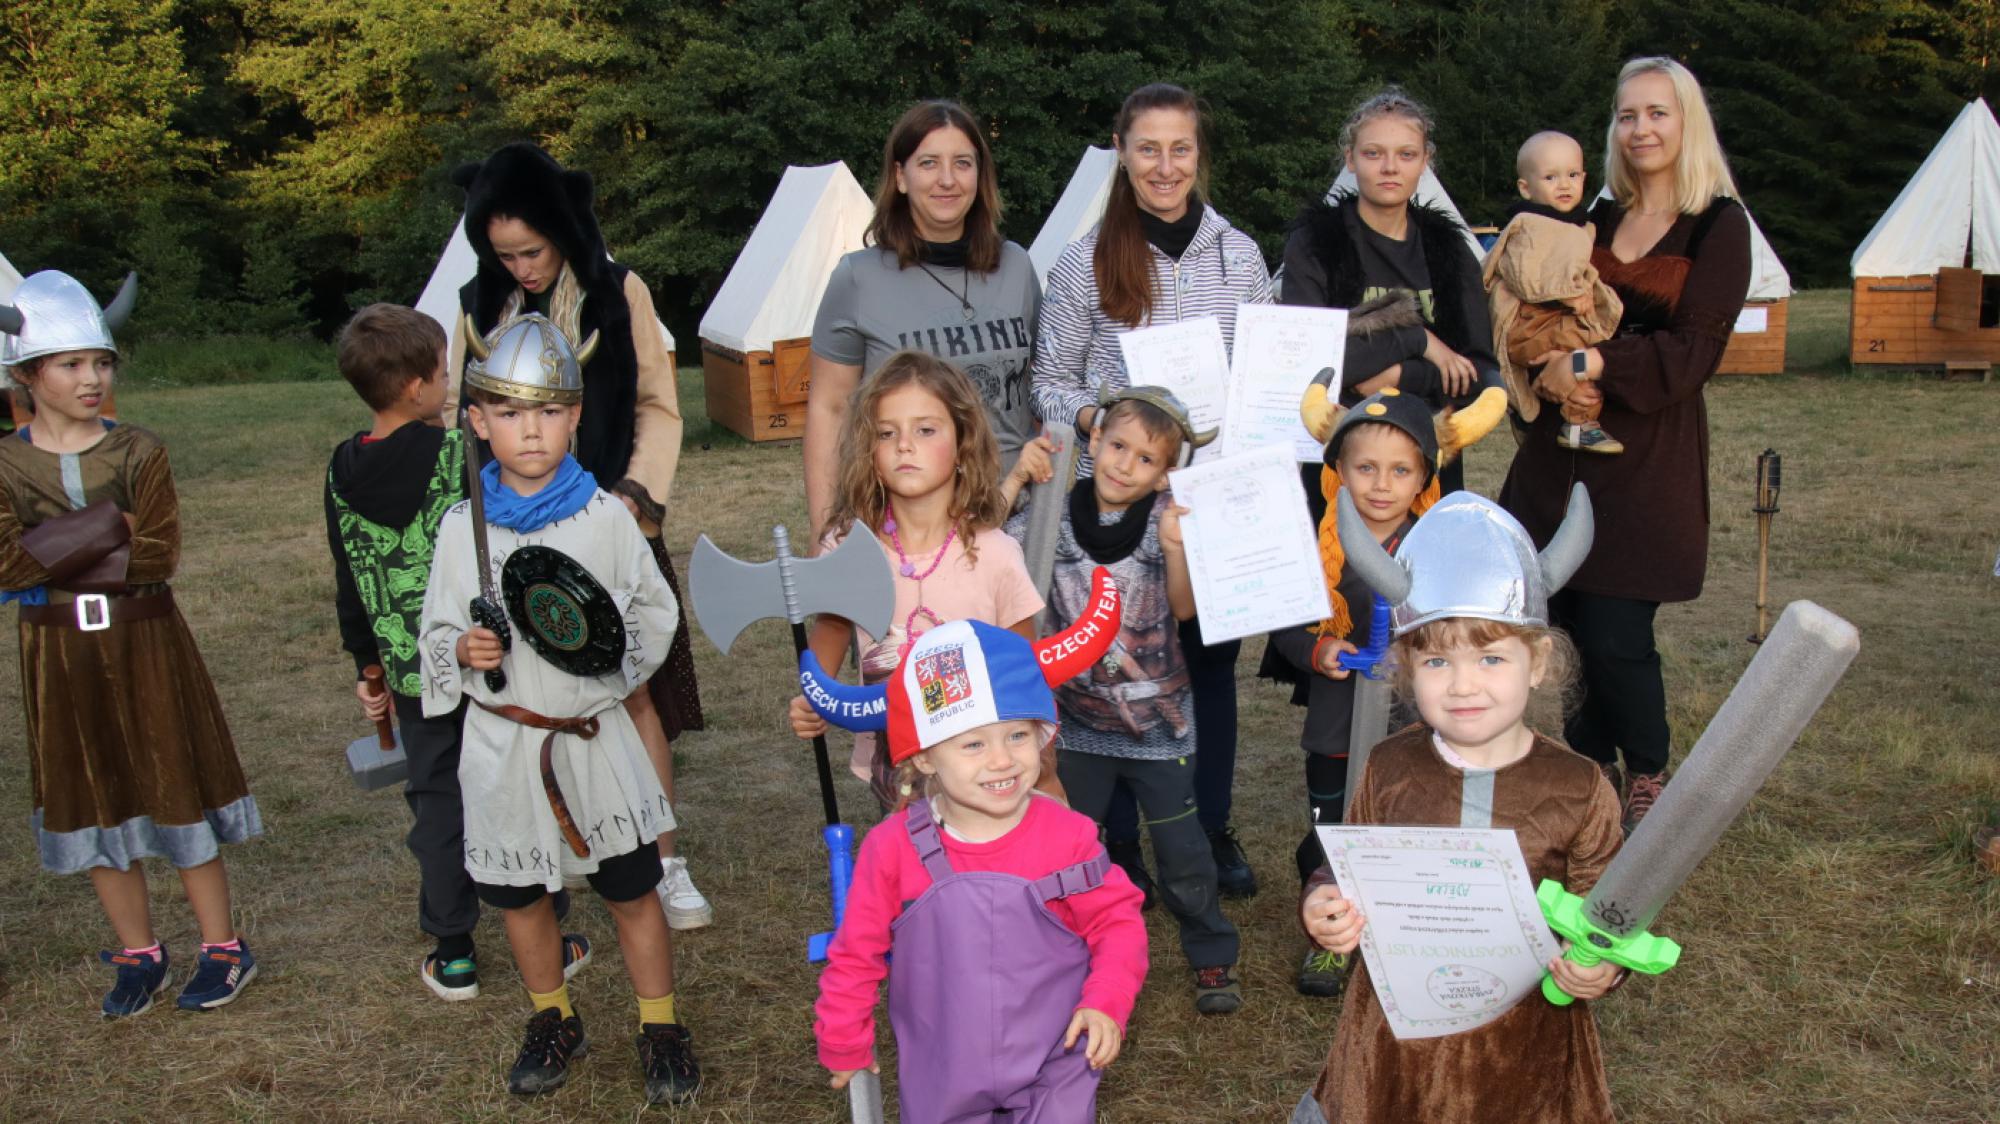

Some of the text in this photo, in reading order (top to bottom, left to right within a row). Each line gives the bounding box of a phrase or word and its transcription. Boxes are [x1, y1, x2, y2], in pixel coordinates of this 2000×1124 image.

[1869, 339, 1885, 352] 21
[768, 414, 787, 428] 25
[1040, 576, 1118, 665] CZECH TEAM
[915, 642, 965, 660] CZECH
[801, 671, 886, 717] CZECH TEAM
[929, 699, 975, 726] REPUBLIC
